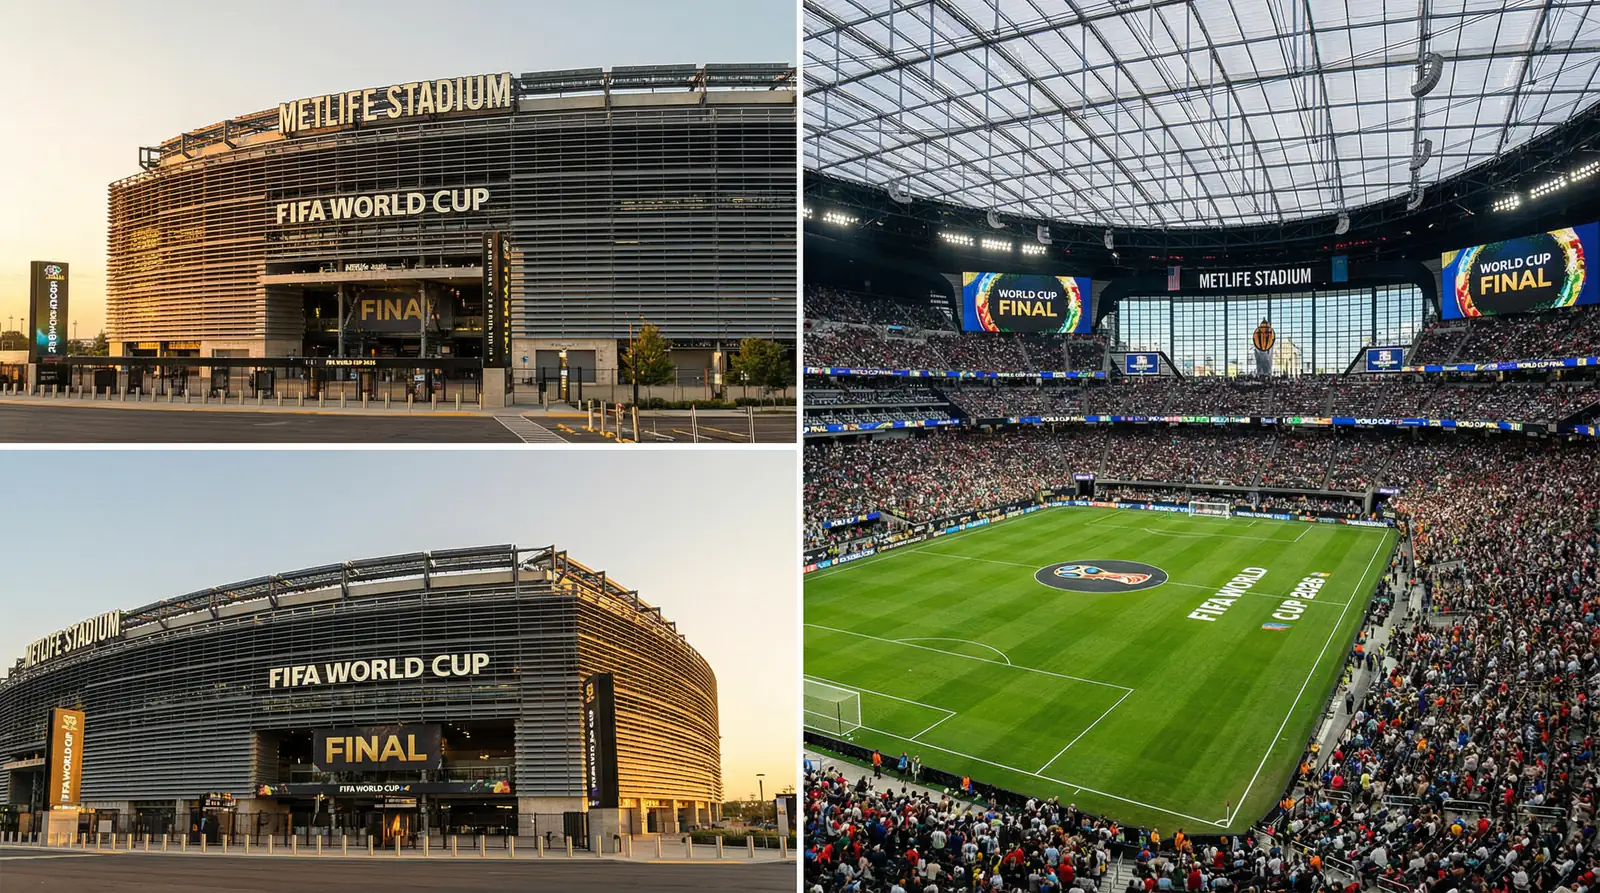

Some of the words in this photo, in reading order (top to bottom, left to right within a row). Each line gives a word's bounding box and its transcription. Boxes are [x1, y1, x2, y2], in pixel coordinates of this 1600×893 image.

[279, 88, 377, 134] METLIFE
[387, 72, 511, 119] STADIUM
[277, 200, 325, 225] FIFA
[330, 192, 426, 220] WORLD
[433, 188, 490, 213] CUP
[1480, 257, 1523, 274] WORLD
[1525, 252, 1552, 267] CUP
[1199, 271, 1252, 289] METLIFE
[1254, 267, 1312, 287] STADIUM
[1480, 267, 1553, 296] FINAL
[998, 289, 1036, 299] WORLD
[1037, 290, 1058, 300] CUP
[999, 300, 1058, 317] FINAL
[1187, 598, 1238, 622] FIFA
[1215, 566, 1269, 598] WORLD
[1289, 576, 1326, 600] 2026
[1271, 599, 1308, 621] CUP
[25, 630, 63, 669] METLIFE
[64, 608, 121, 653] STADIUM
[269, 663, 321, 689] FIFA
[325, 656, 425, 683] WORLD
[431, 652, 490, 677] CUP
[64, 731, 73, 747] CUP
[325, 733, 428, 764] FINAL
[62, 747, 73, 781] WORLD
[339, 785, 356, 793] FIFA
[356, 784, 383, 793] WORLD
[384, 784, 400, 792] CUP
